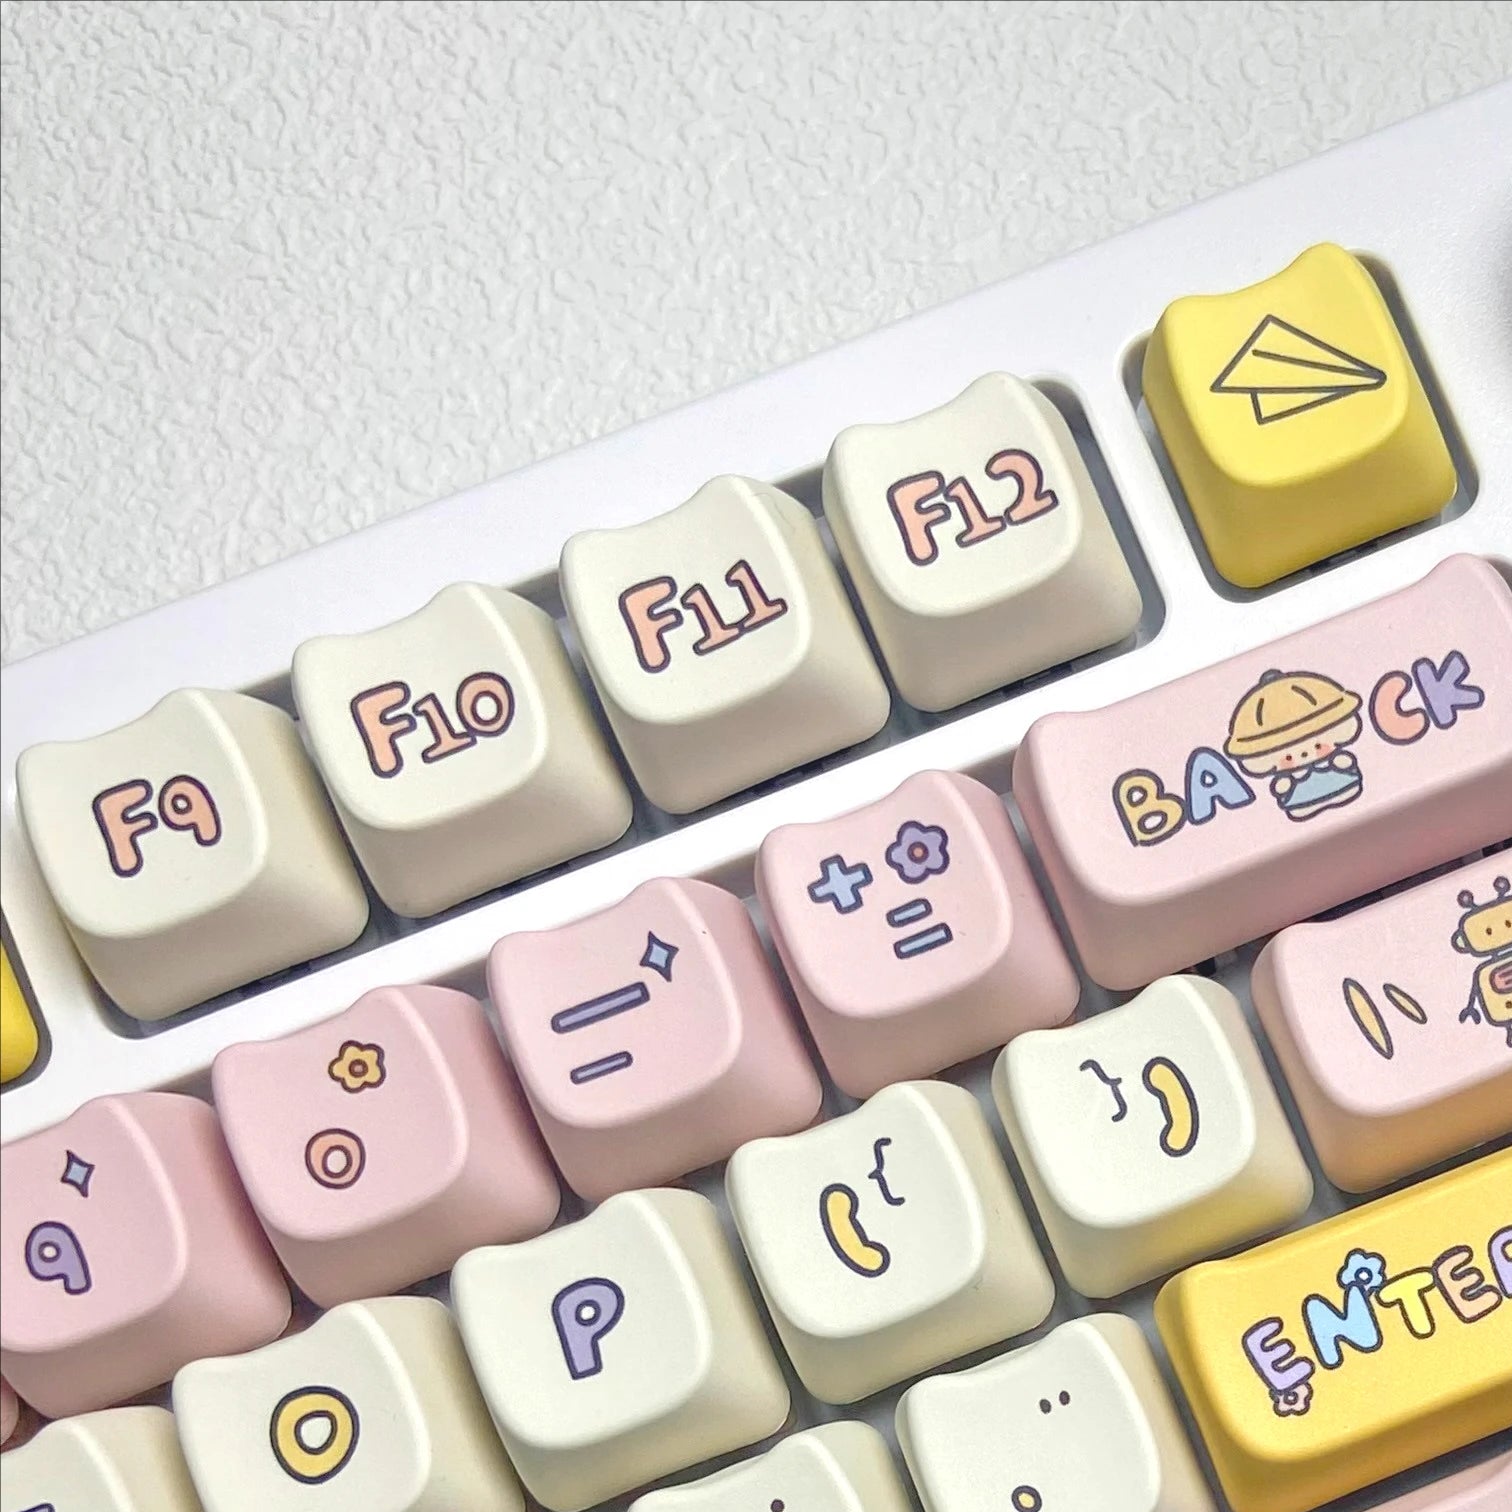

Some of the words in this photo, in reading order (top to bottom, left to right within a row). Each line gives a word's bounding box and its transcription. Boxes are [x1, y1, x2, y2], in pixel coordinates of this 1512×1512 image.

[885, 447, 1059, 567] F12
[617, 558, 788, 674] F11
[349, 670, 516, 778] F10
[91, 774, 223, 878] F9
[24, 1220, 93, 1297] 9
[550, 1276, 625, 1382] P
[269, 1384, 360, 1486] O
